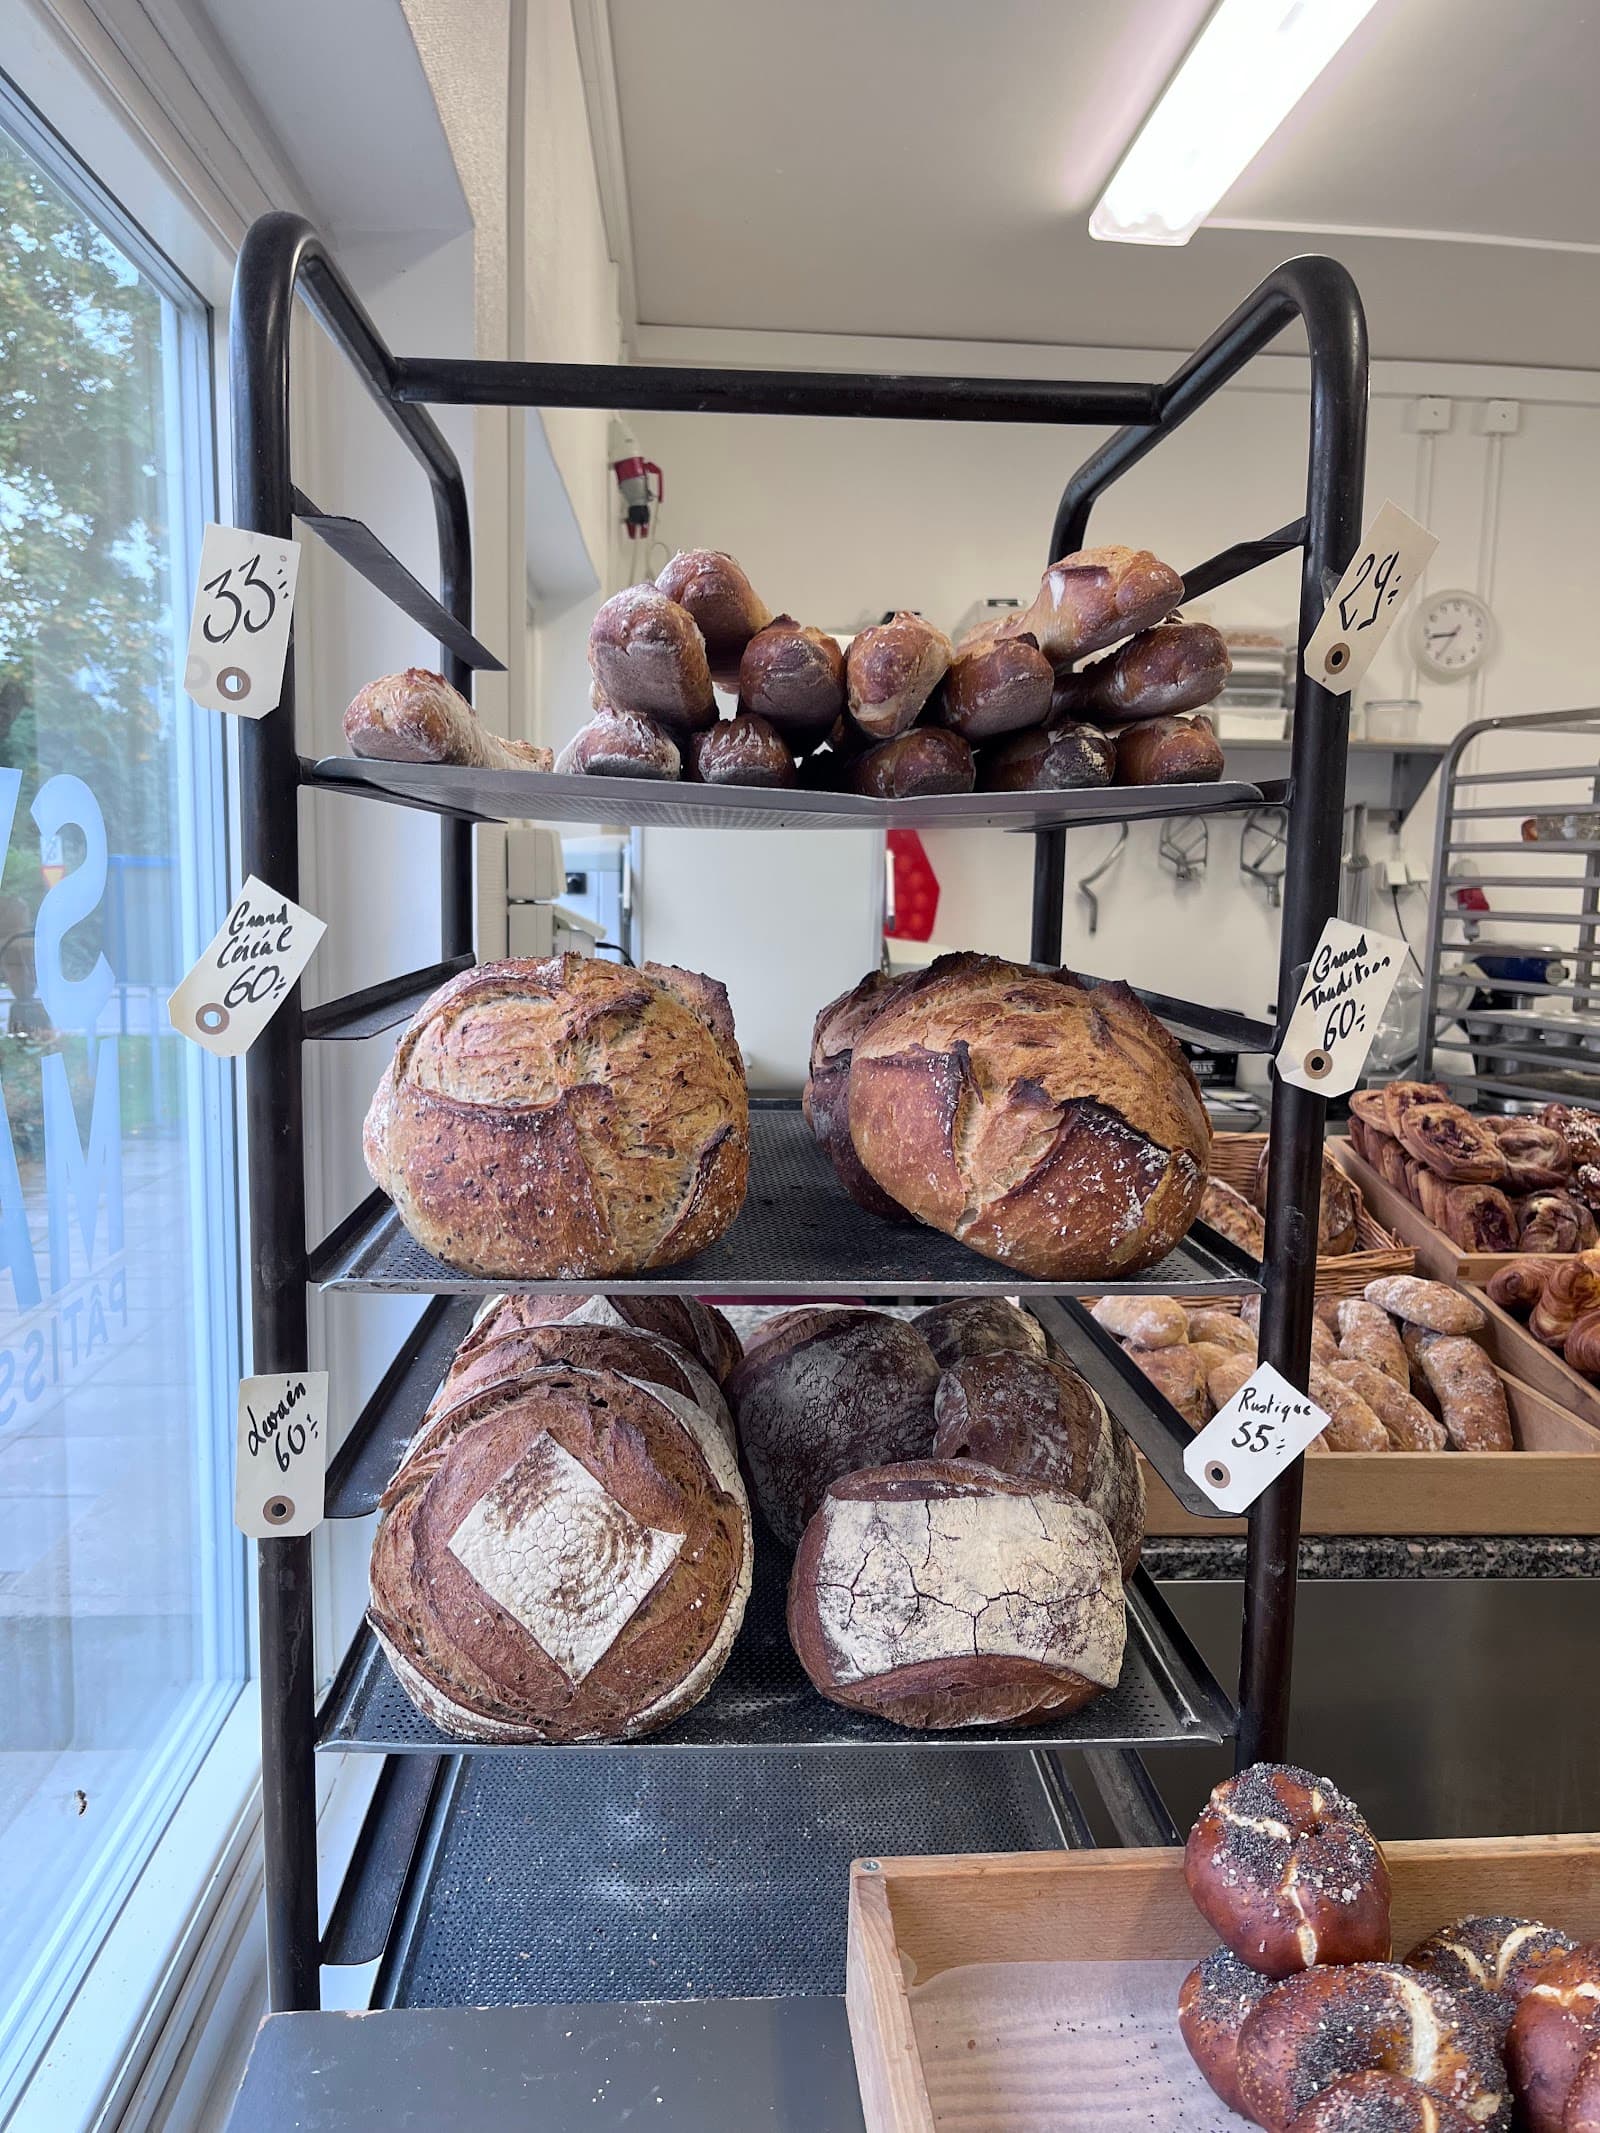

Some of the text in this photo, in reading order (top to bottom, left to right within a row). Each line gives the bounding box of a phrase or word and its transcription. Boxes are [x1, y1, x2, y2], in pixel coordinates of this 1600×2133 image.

[228, 900, 289, 936] Grand
[1312, 934, 1368, 983] Grand
[1238, 1387, 1312, 1423] Rustique
